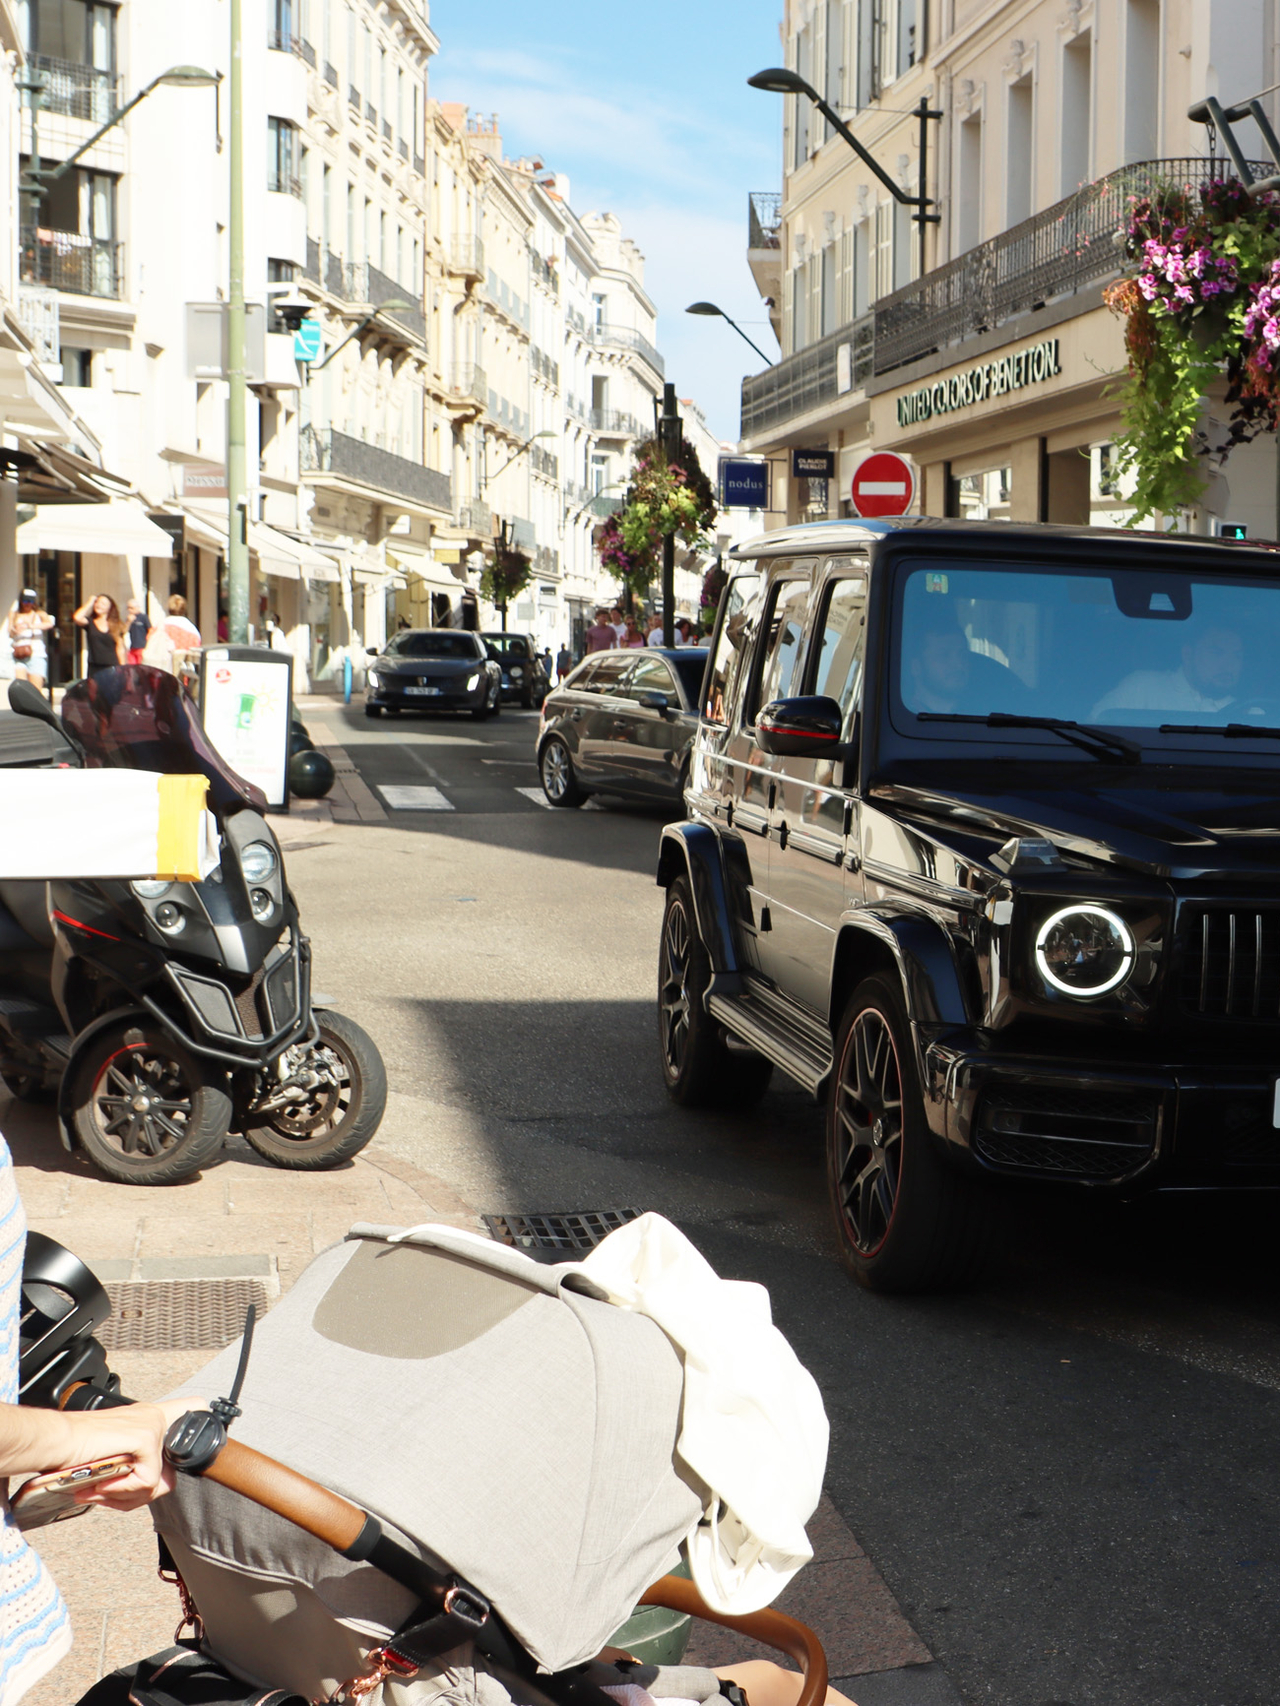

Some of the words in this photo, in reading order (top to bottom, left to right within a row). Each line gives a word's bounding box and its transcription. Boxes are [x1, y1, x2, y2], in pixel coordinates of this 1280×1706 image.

[897, 388, 932, 427] UNITED
[931, 370, 974, 415] COLORS
[973, 364, 992, 402] OF
[728, 477, 764, 489] nodus
